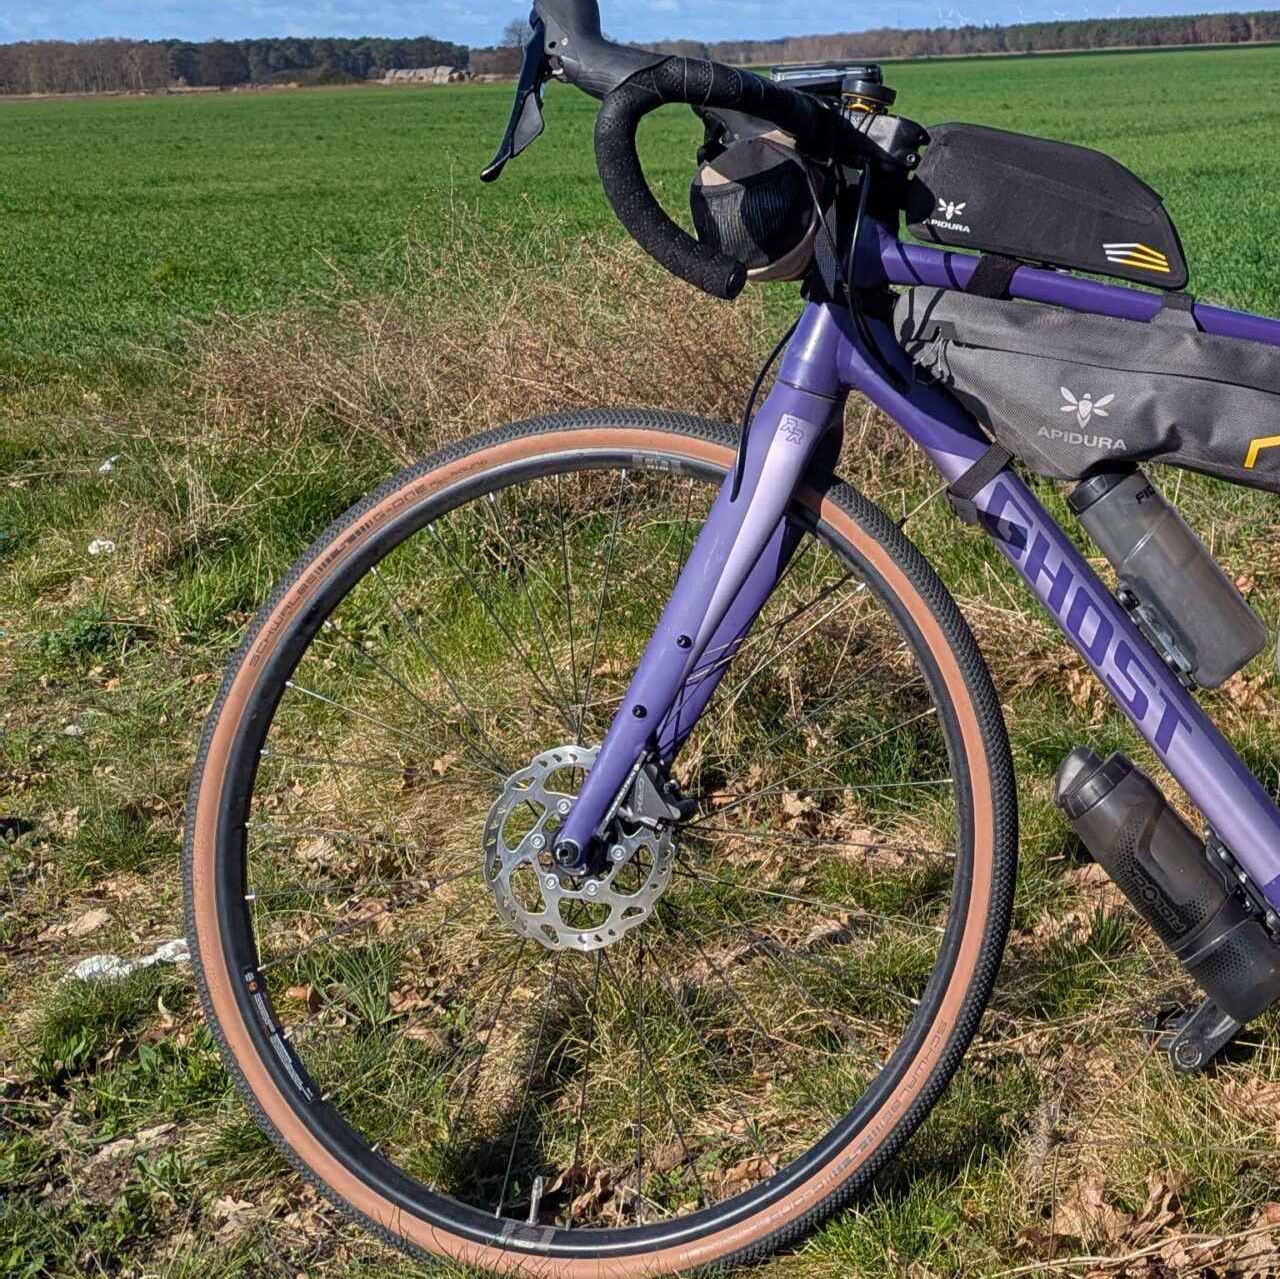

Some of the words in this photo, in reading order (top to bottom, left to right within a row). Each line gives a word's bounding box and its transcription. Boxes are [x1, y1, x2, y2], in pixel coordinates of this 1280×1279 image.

[923, 218, 970, 233] APIDURA
[1038, 426, 1127, 451] APIDURA
[249, 572, 318, 667] SCHWALBE
[982, 481, 1193, 755] GHOST
[1127, 864, 1186, 933] FIDLOCK
[883, 1022, 947, 1125] SCHWALBE
